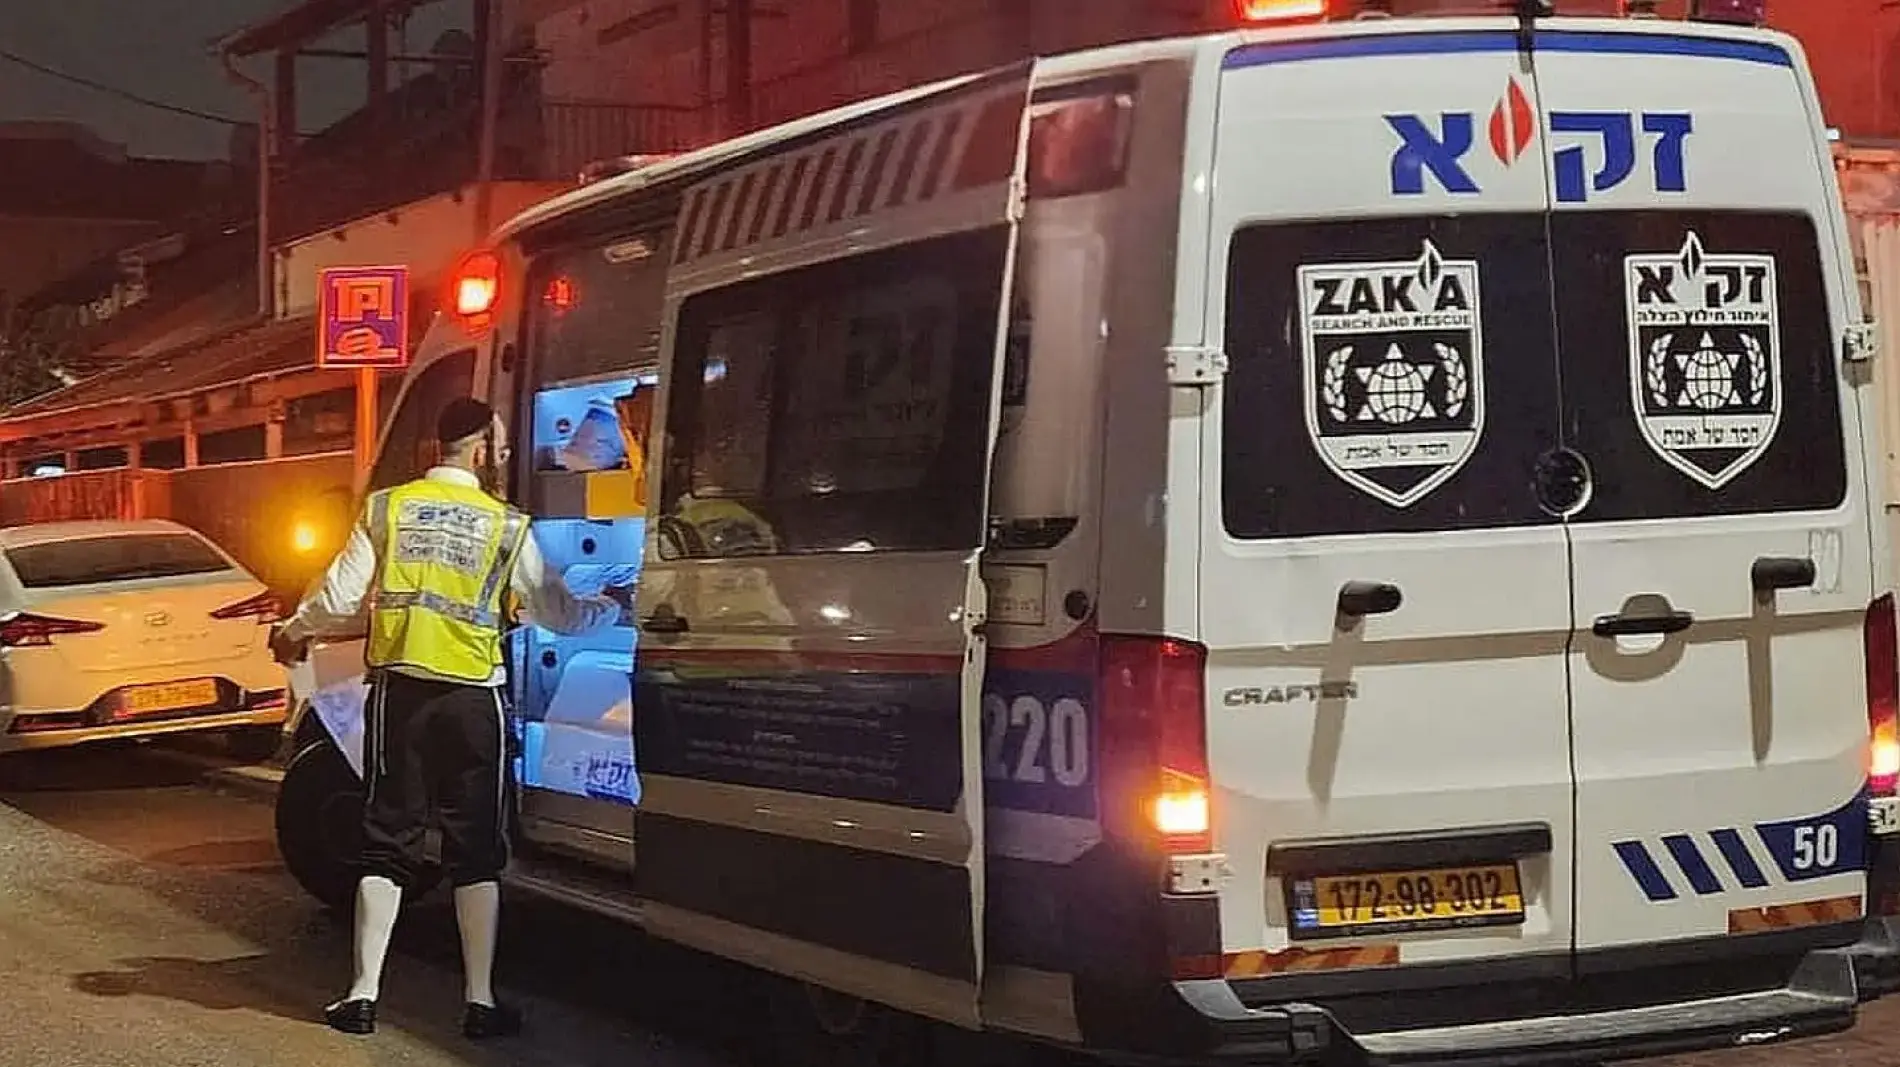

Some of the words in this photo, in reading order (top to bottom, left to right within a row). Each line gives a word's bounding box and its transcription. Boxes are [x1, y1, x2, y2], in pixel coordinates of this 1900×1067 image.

[1312, 316, 1373, 330] SEARCH
[1378, 314, 1410, 328] AND
[1414, 312, 1471, 327] RESCUE
[1223, 681, 1358, 706] CRAFTER
[1793, 824, 1838, 870] 50
